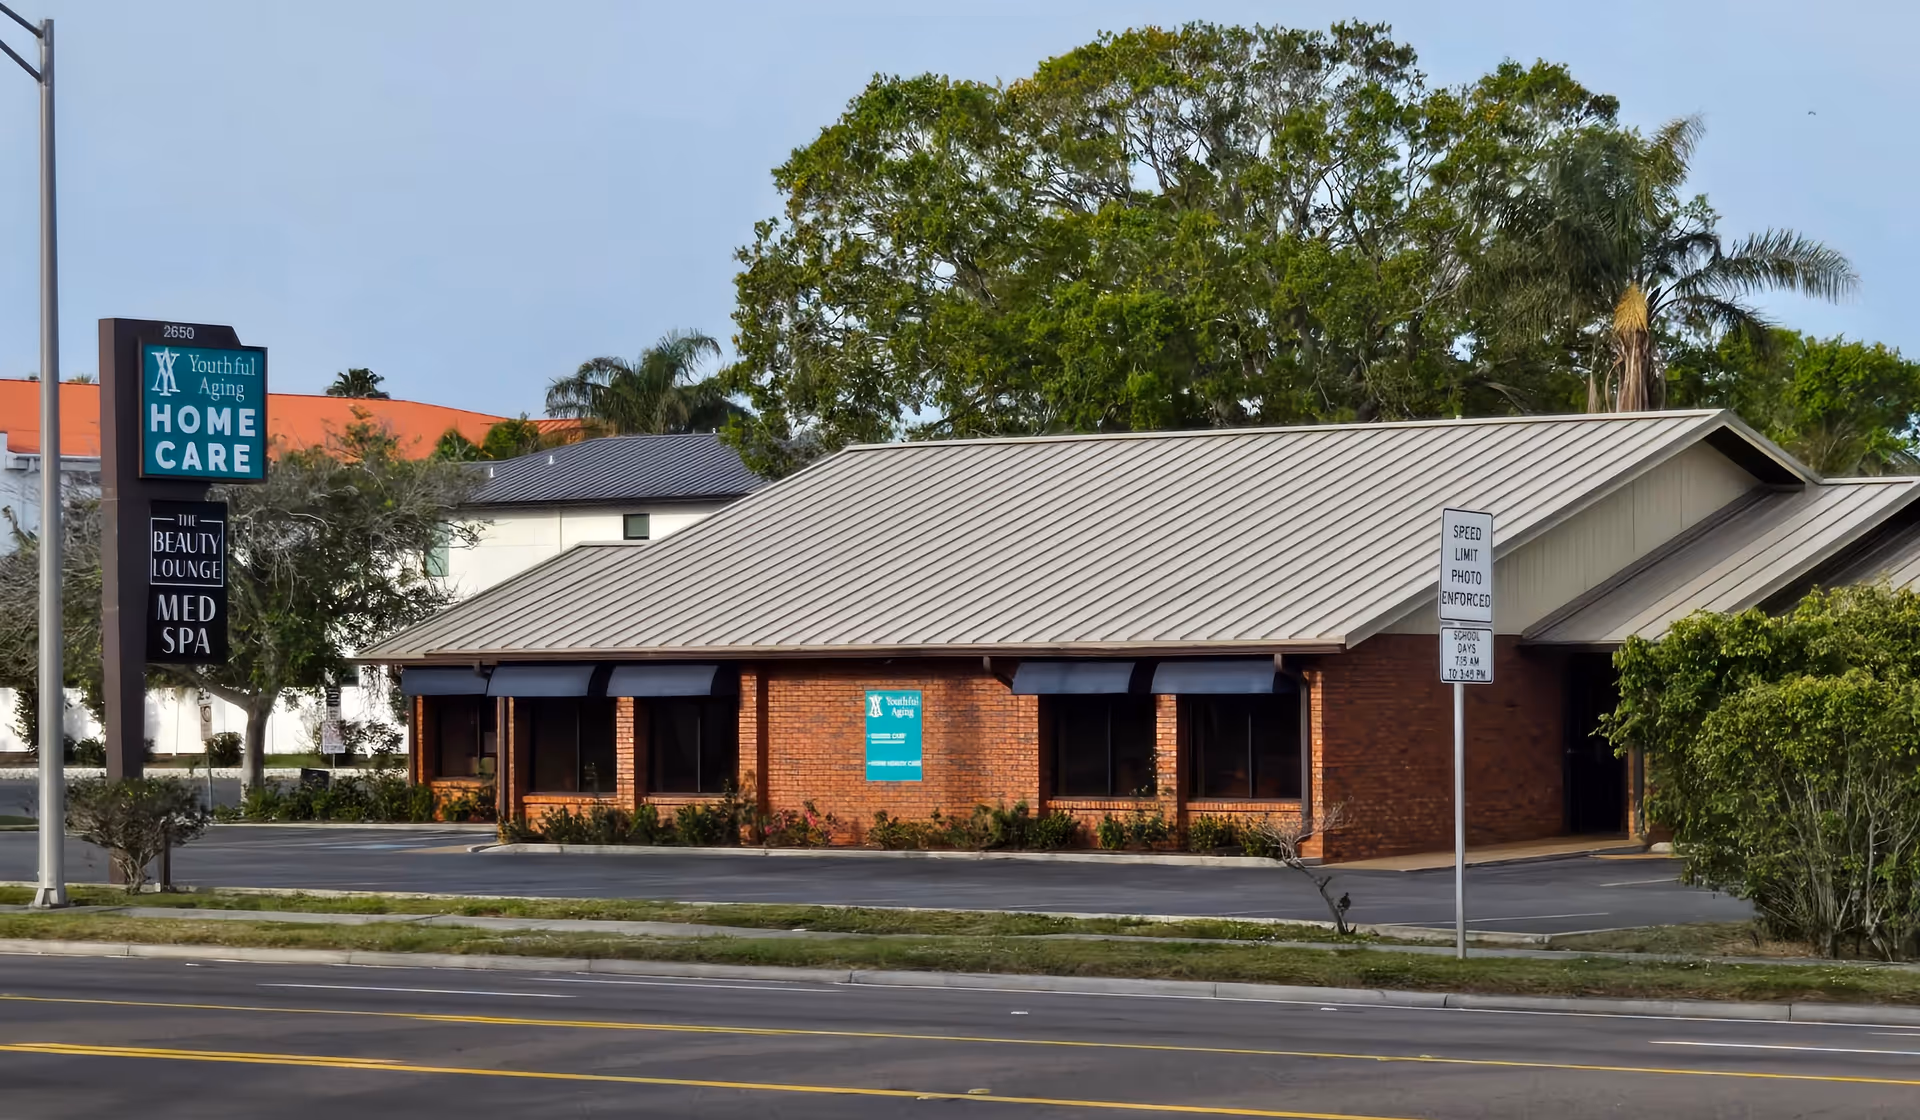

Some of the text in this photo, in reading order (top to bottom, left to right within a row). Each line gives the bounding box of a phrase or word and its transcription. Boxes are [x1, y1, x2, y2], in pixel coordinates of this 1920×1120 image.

[164, 325, 194, 339] 2650
[188, 354, 256, 376] Youthful
[198, 376, 245, 402] Aging
[150, 403, 256, 437] HOME
[155, 440, 251, 473] CARE
[178, 514, 197, 527] THE
[1453, 524, 1482, 541] SPEED
[153, 531, 220, 554] BEAUTY
[1455, 547, 1478, 562] LIMIT
[153, 558, 221, 579] LOUNGE
[1451, 569, 1482, 585] PHOTO
[1441, 590, 1491, 608] ENFORCED
[157, 594, 216, 622] MED
[162, 626, 211, 654] SPA
[1453, 630, 1480, 641] SCHOOL
[1457, 643, 1476, 654] DAYS
[1448, 668, 1457, 679] TO
[1476, 669, 1486, 680] PM
[885, 696, 919, 706] Youthful
[891, 706, 915, 718] Aging
